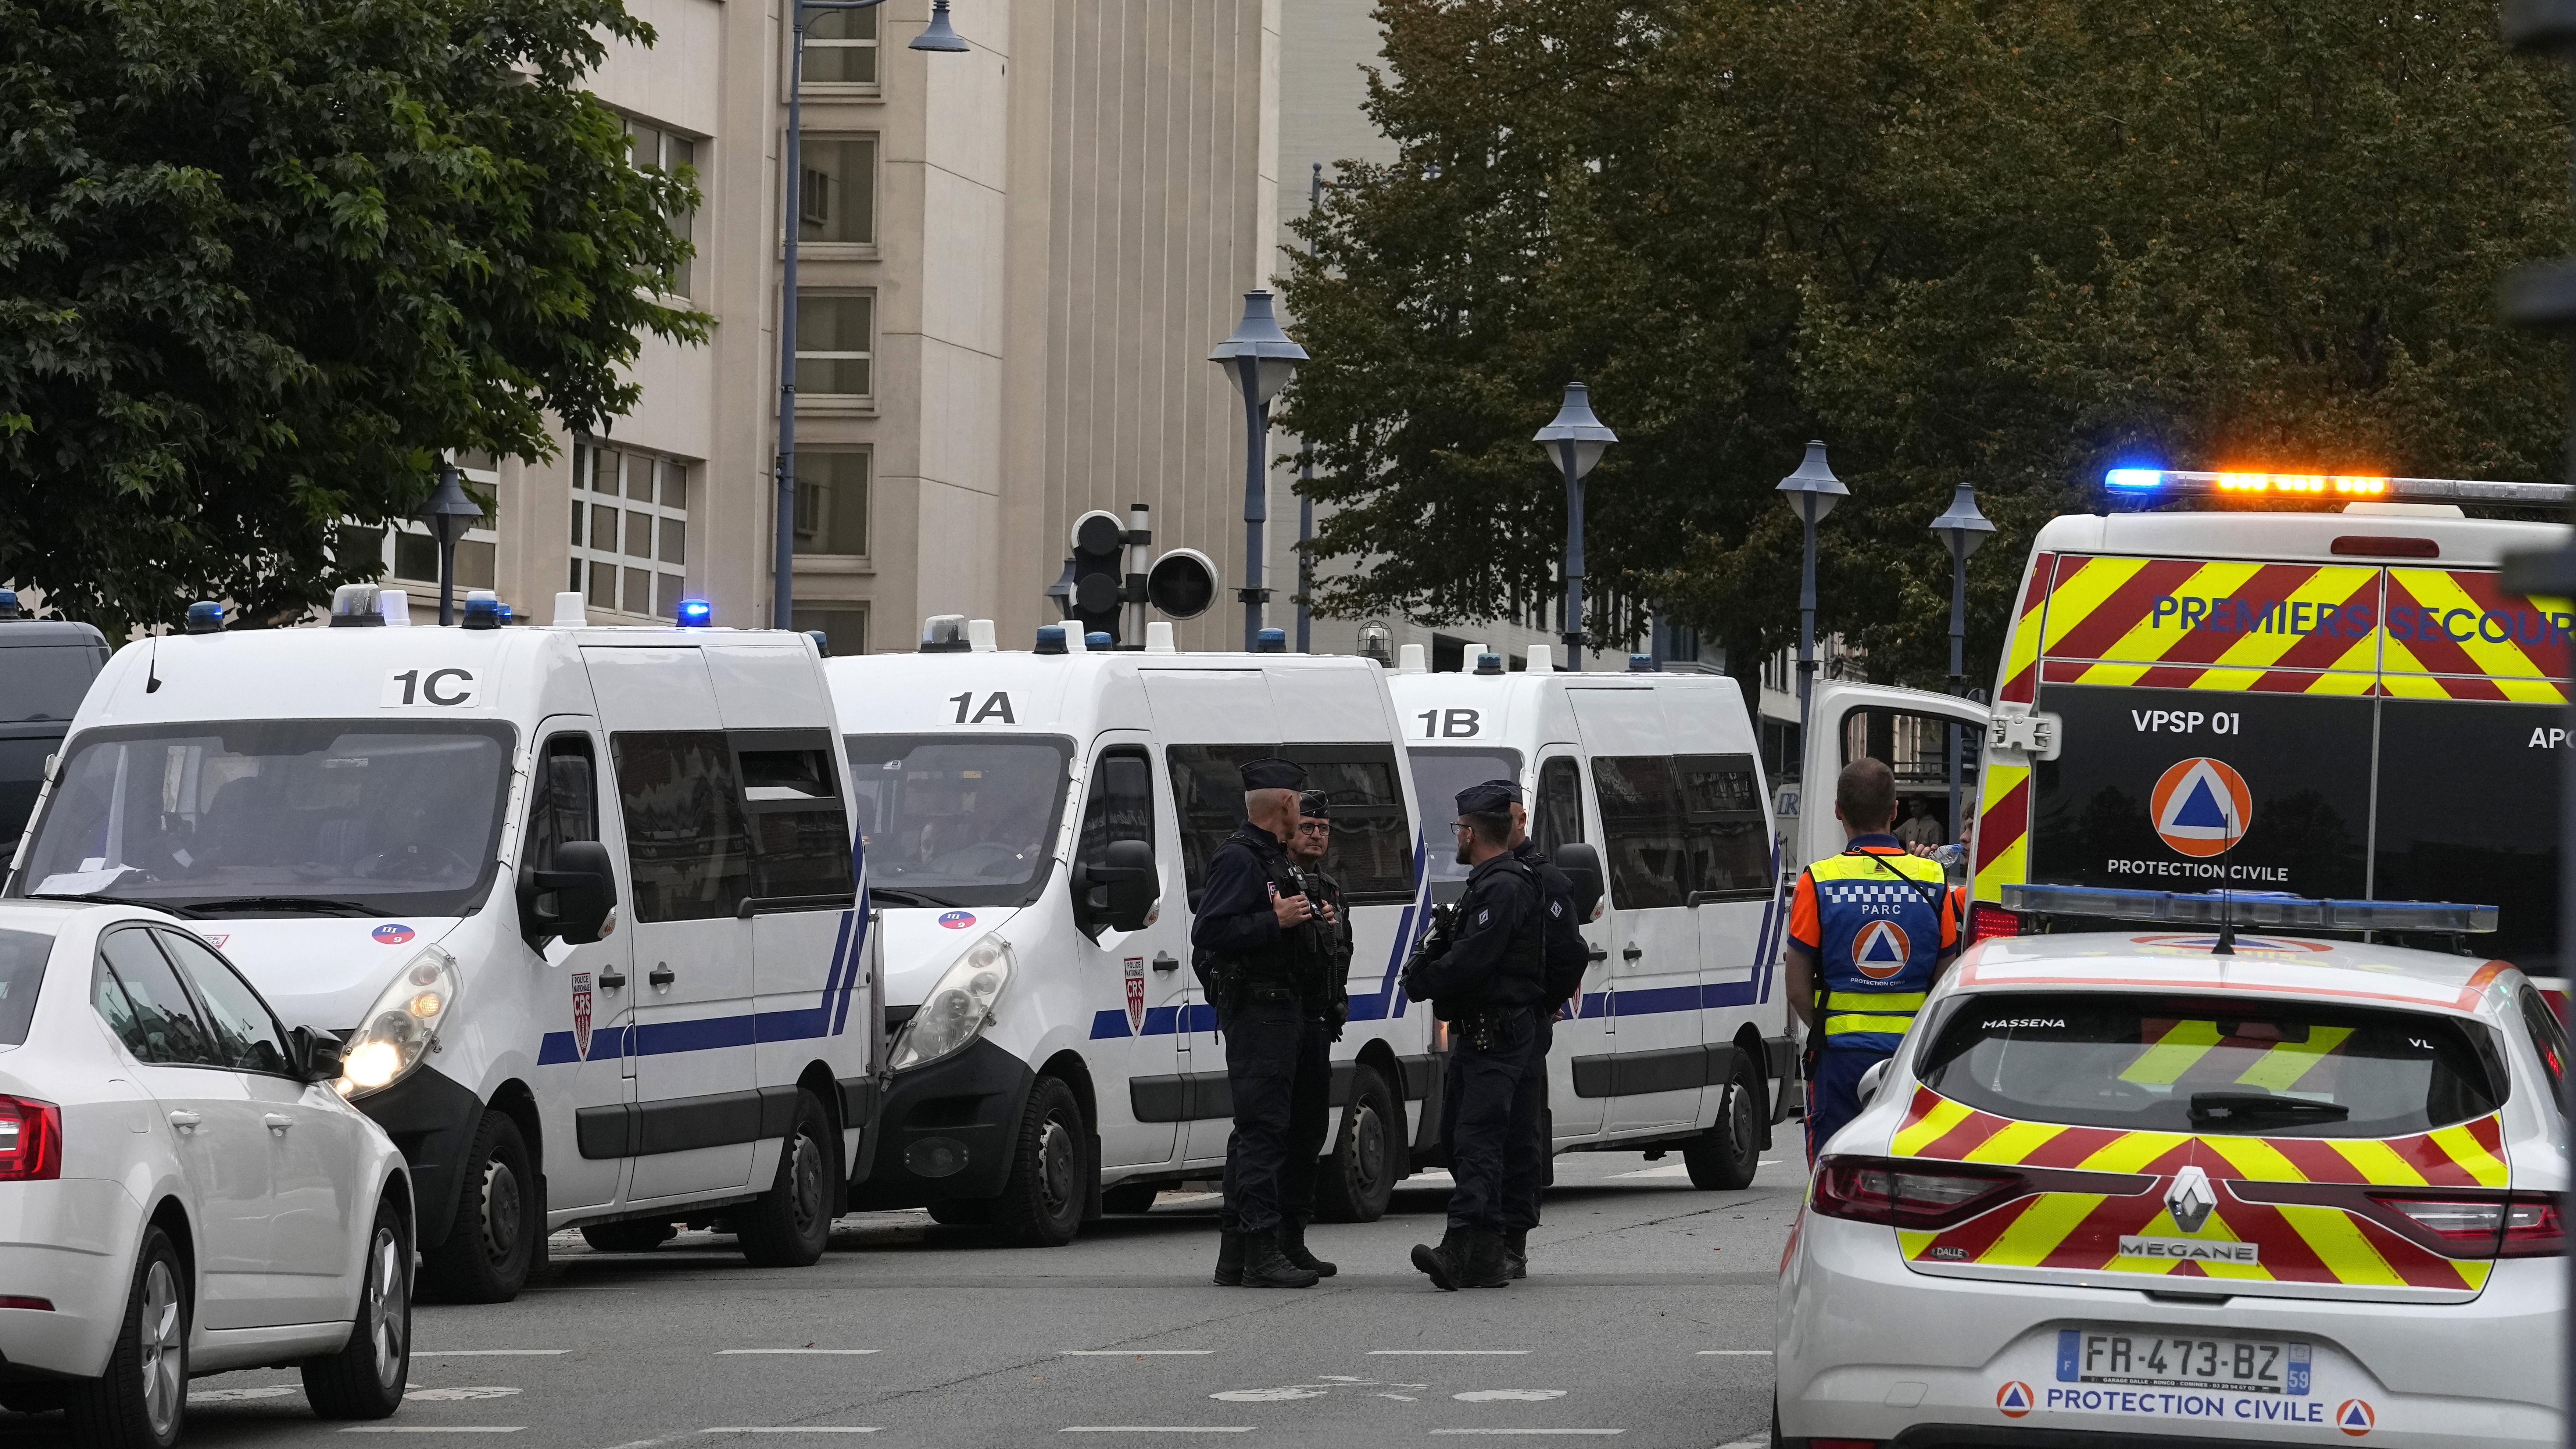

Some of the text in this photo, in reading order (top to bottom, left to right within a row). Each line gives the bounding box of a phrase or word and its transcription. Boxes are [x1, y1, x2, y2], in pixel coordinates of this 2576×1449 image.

[2153, 595, 2371, 638] PREMIERS
[393, 668, 473, 705] 1C
[949, 692, 1015, 724] 1A
[1418, 709, 1479, 737] 1B
[2132, 710, 2239, 734] VPSP 01
[2108, 859, 2289, 881] PROTECTION CIVILE
[1862, 904, 1901, 914] PARC
[573, 984, 590, 993] NATIONALE
[574, 975, 588, 984] POLICE
[1127, 980, 1143, 998] CRS
[1850, 978, 1888, 986] PROTECTION
[574, 994, 591, 1016] CRS
[1982, 1019, 2065, 1029] MASSENA
[2408, 1038, 2434, 1049] VL
[1937, 1248, 1964, 1257] DALLE
[2121, 1240, 2253, 1261] MEGANE
[2064, 1361, 2071, 1371] F
[2086, 1336, 2281, 1382] FR-473-BZ
[2289, 1370, 2309, 1388] 59
[2047, 1388, 2324, 1423] PROTECTION CIVILE
